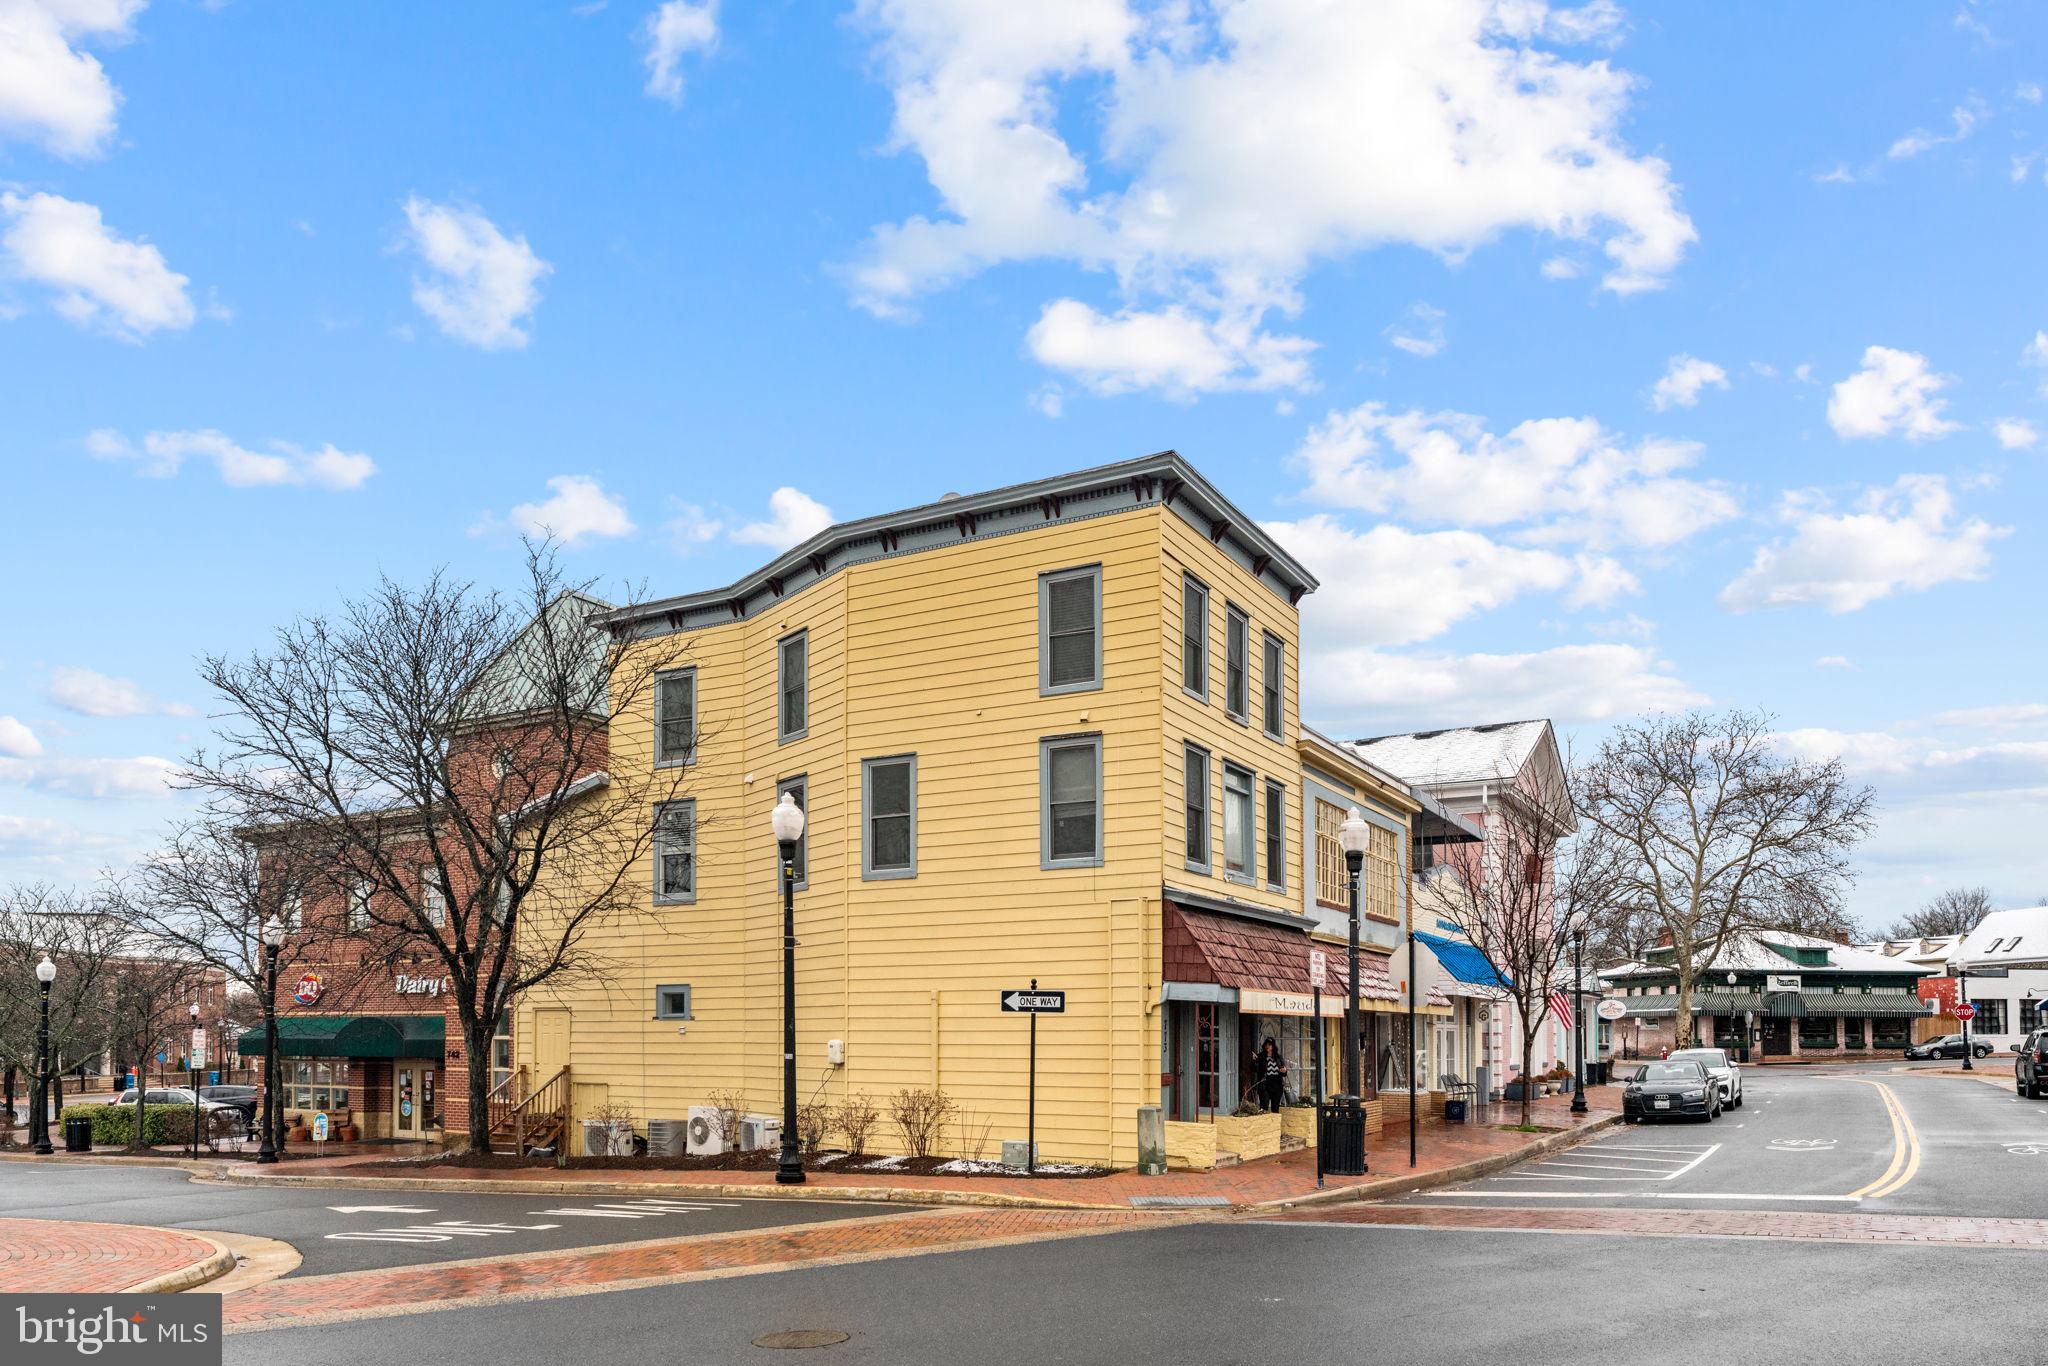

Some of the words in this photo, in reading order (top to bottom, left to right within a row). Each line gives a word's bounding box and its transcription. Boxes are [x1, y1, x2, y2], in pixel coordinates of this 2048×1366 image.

[395, 975, 438, 997] Dairy
[1019, 997, 1037, 1006] ONE
[1040, 997, 1058, 1007] WAY
[1271, 997, 1315, 1011] Maud
[1956, 1008, 1974, 1016] STOP
